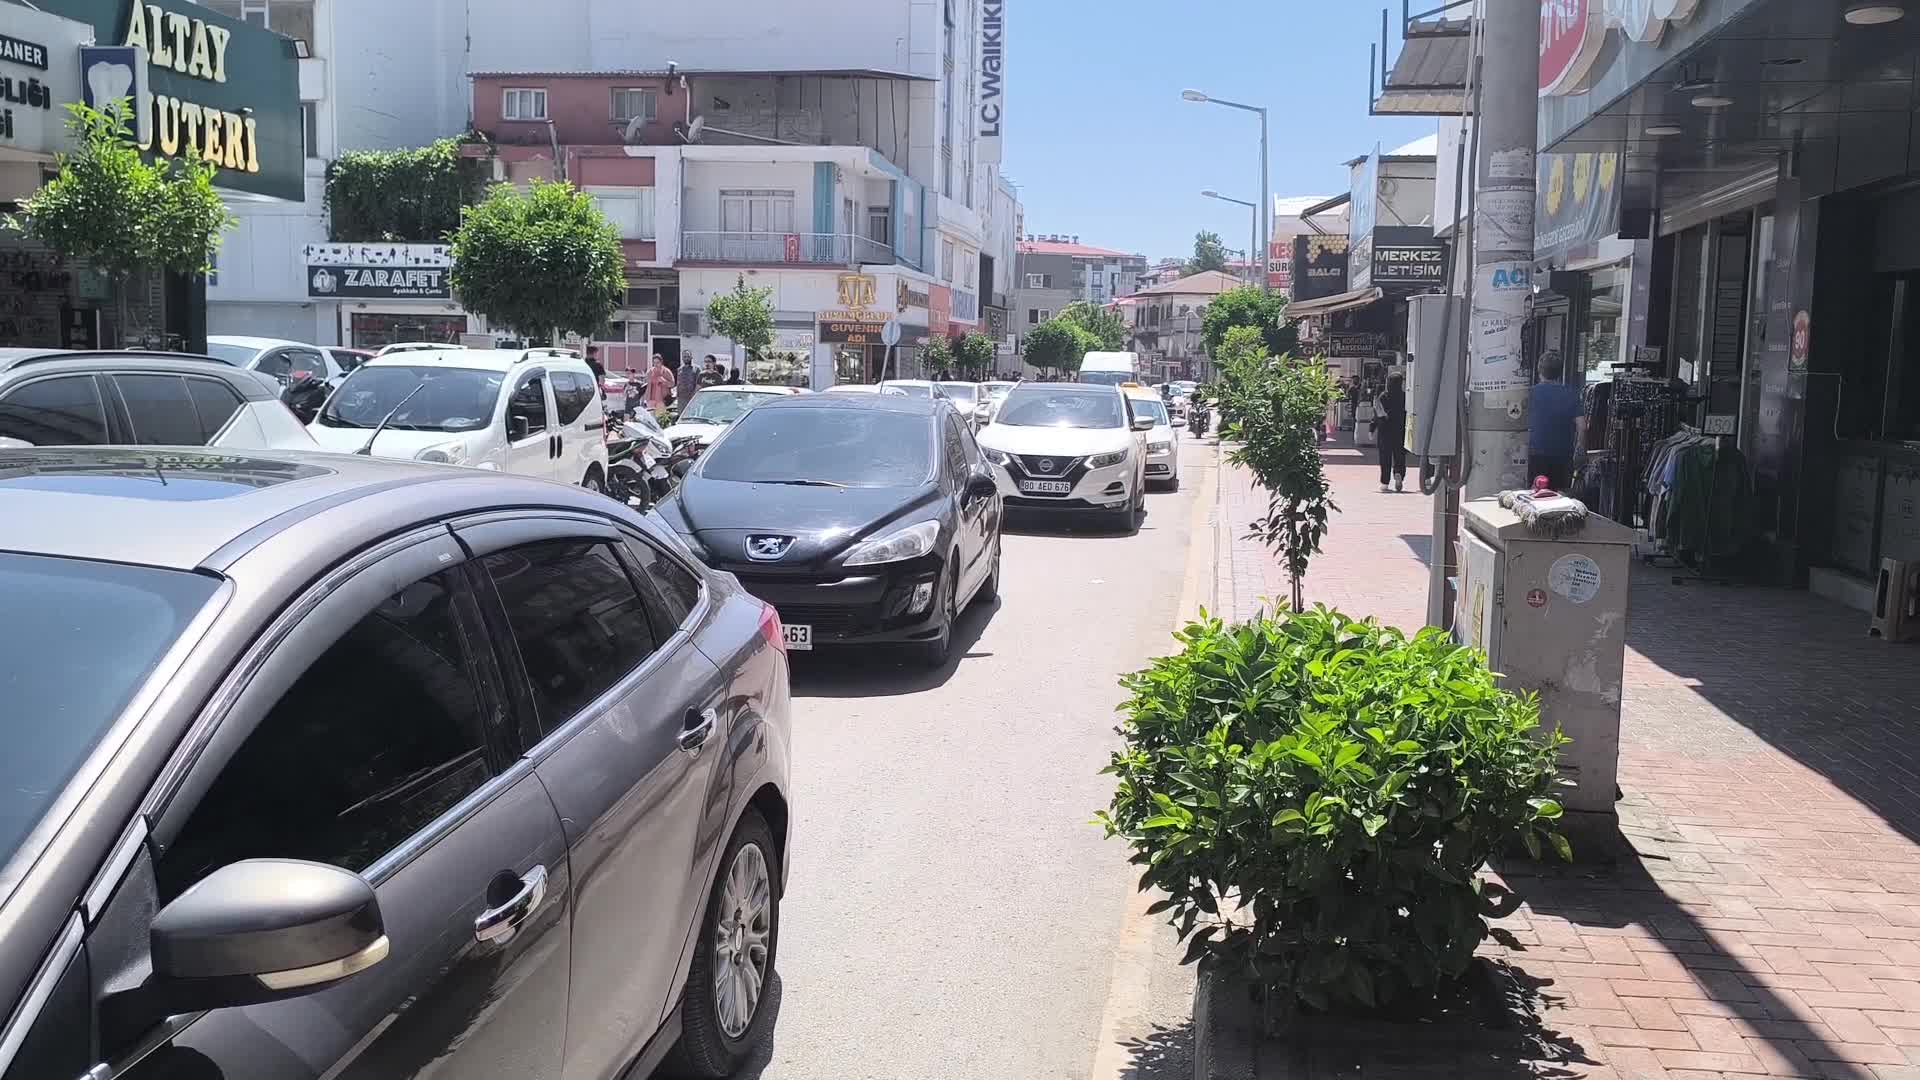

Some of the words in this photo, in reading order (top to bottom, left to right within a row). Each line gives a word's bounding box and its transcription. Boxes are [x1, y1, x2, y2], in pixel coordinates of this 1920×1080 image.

[125, 0, 230, 83] ALTAY
[0, 40, 42, 65] ANER
[980, 104, 1000, 137] LC
[1375, 250, 1442, 261] MERKEZ
[344, 269, 442, 287] ZARAFET
[1374, 263, 1442, 278] İLETİŞİM
[1024, 481, 1034, 490] 80
[1039, 482, 1053, 491] AED
[1055, 483, 1069, 492] 676
